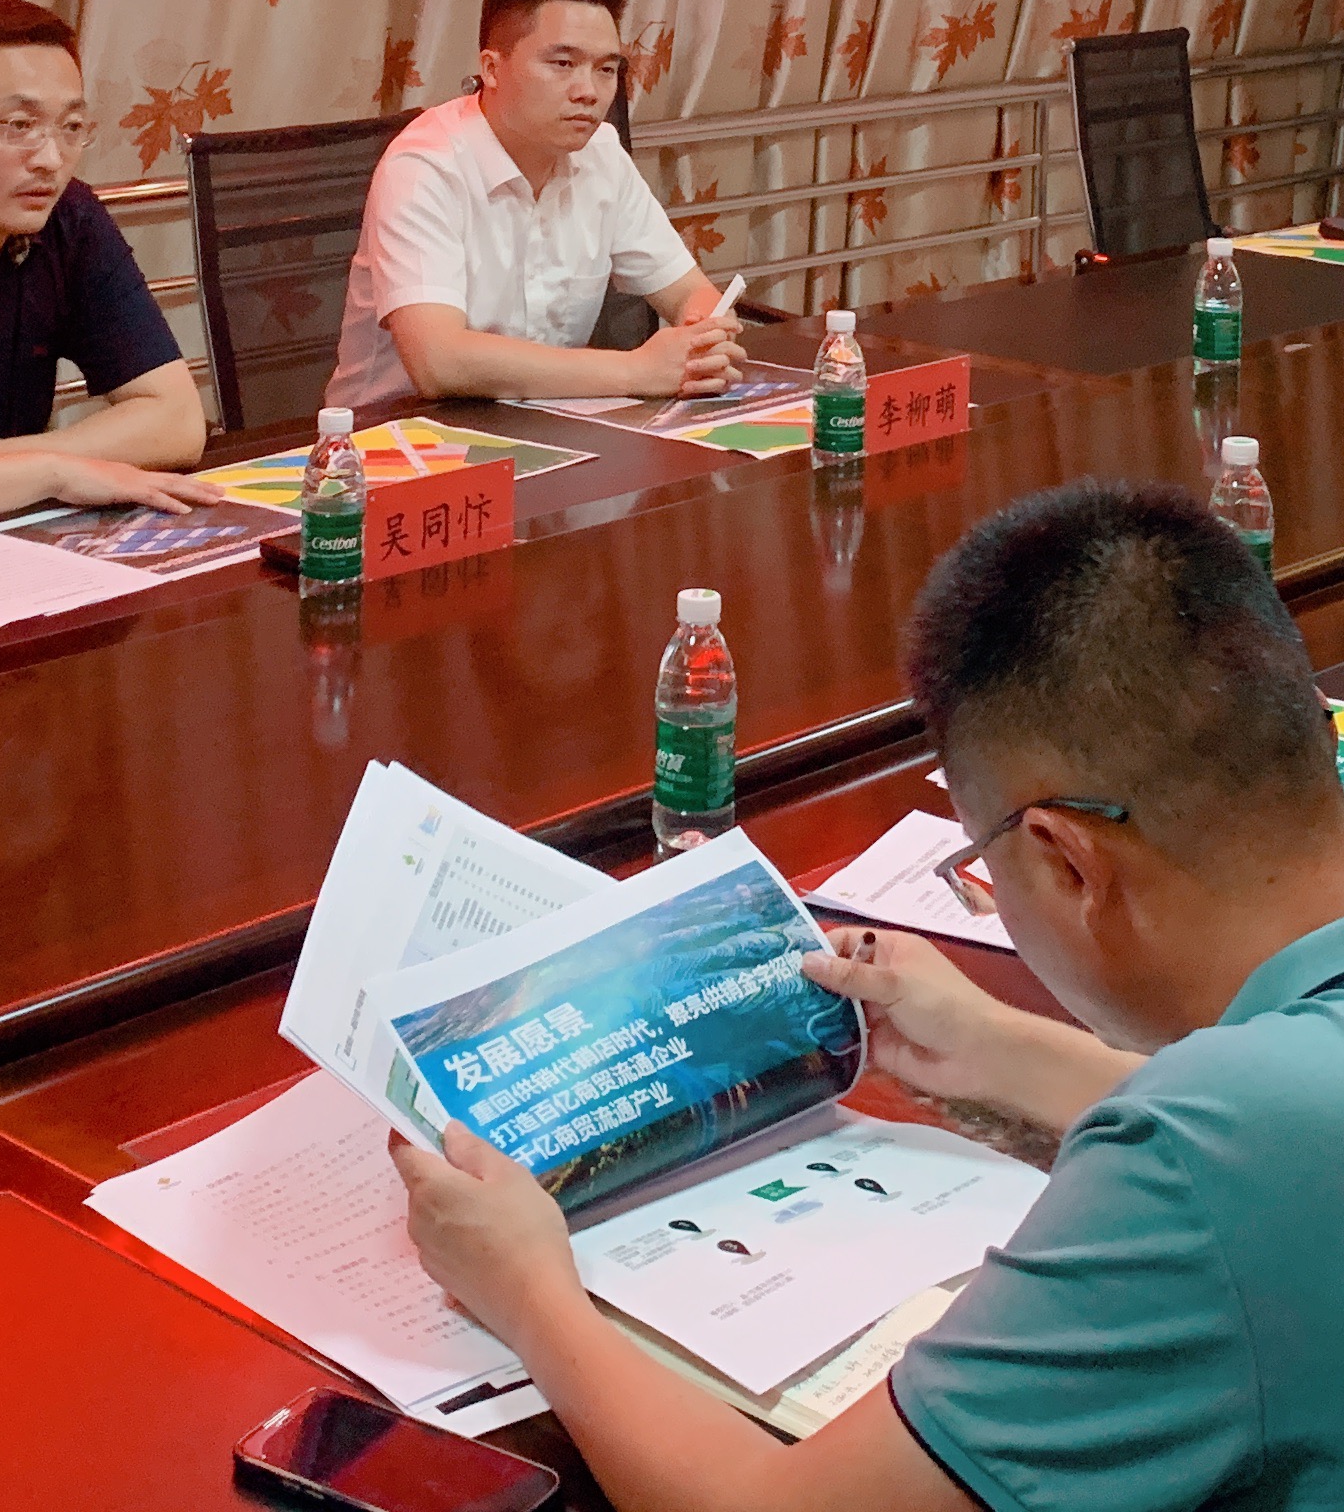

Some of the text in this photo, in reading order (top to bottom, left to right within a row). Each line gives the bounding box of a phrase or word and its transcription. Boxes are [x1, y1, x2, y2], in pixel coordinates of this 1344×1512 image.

[878, 383, 957, 436] 李柳萌
[380, 493, 493, 561] 吴同忭
[443, 1001, 594, 1092] 发展愿景
[489, 1035, 694, 1149] 打造百亿商贸流通企业
[509, 1080, 675, 1167] 千亿商贸流通产业
